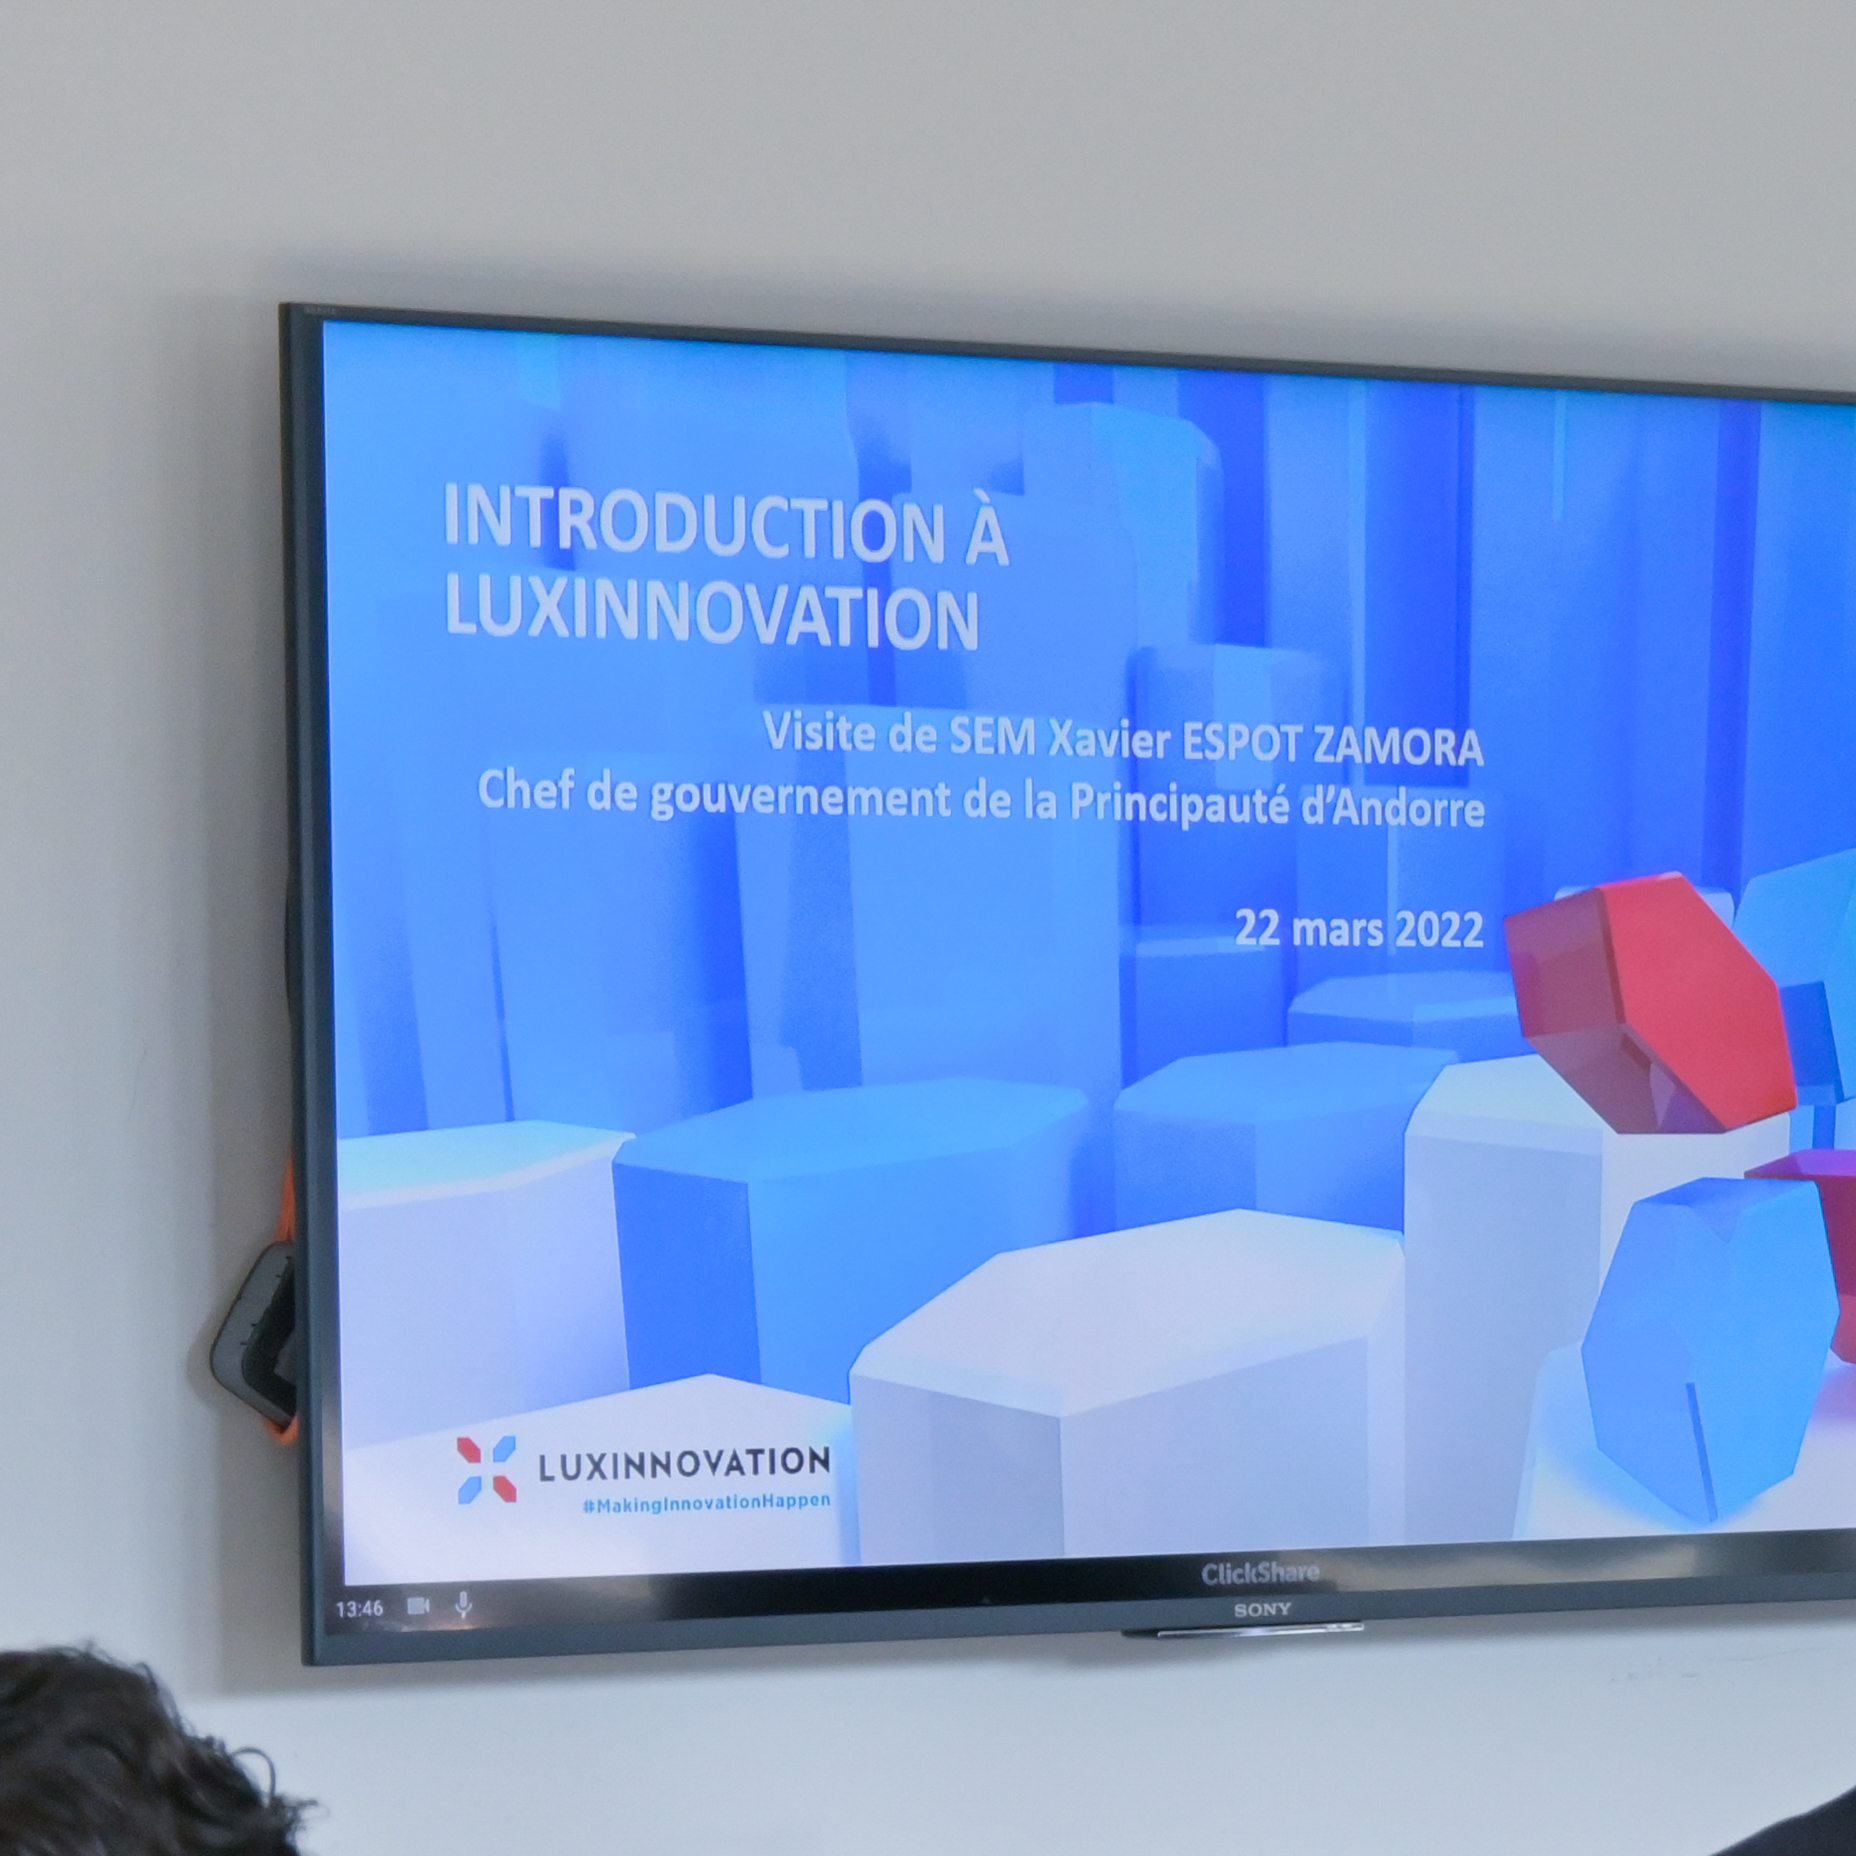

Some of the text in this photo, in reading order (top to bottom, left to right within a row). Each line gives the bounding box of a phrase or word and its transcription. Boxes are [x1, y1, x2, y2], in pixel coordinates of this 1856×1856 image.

[445, 482, 1011, 567] INTRODUCTION À
[445, 572, 980, 651] LUXINNOVATION
[762, 709, 1485, 766] Visite de SEM Xavier ESPOT ZAMORA
[478, 766, 575, 810] Chef
[587, 768, 638, 811] de
[650, 782, 952, 821] gouvernement
[963, 777, 1011, 819] de
[1024, 777, 1057, 820] la
[1071, 780, 1289, 831] Principauté
[1234, 908, 1485, 948] 22 mars 2022
[539, 1445, 831, 1482] LUXINNOVATION
[583, 1492, 831, 1515] #MakingInnovationHappen
[1201, 1560, 1320, 1587] ClickShare
[336, 1599, 384, 1618] 13:46
[1234, 1602, 1292, 1618] SONY
